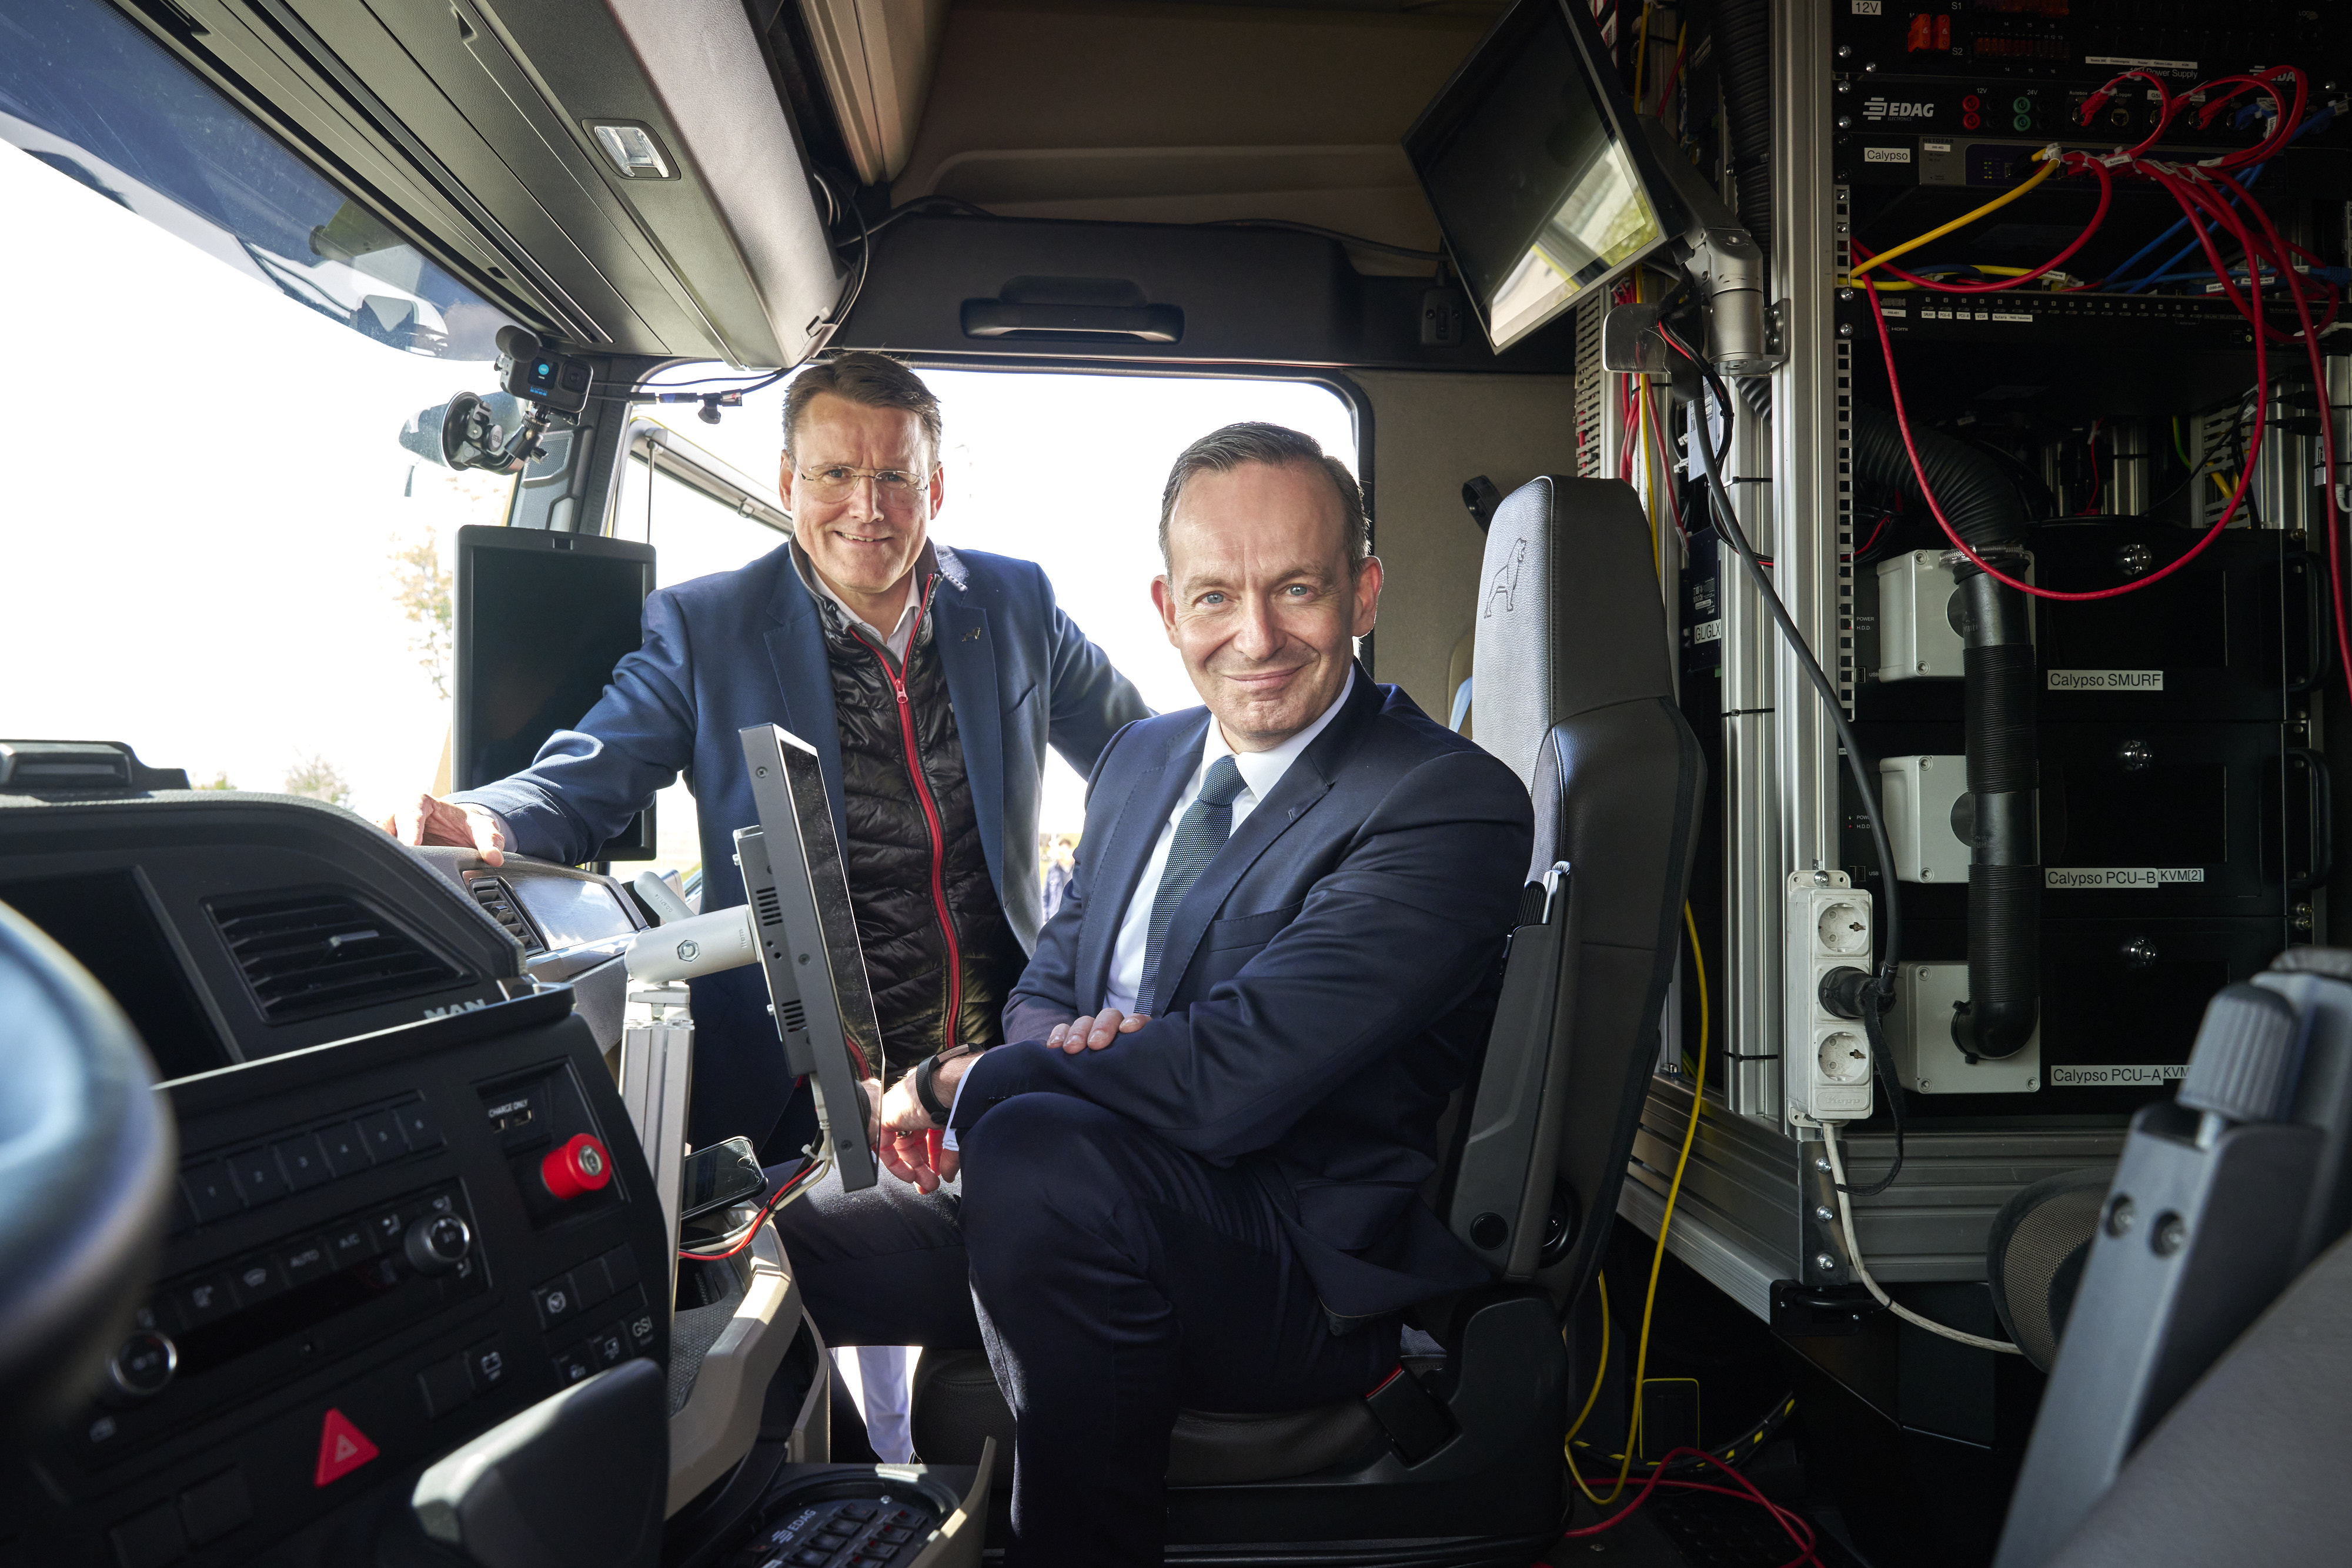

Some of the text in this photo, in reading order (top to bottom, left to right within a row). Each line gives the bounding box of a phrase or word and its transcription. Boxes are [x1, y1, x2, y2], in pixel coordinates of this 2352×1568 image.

[1856, 2, 1878, 13] 12V
[1952, 48, 1963, 56] S2
[2172, 69, 2198, 79] Supply
[1888, 102, 1935, 118] EDAG
[1867, 150, 1908, 162] Calypso
[1695, 622, 1720, 641] GL/GLX
[2050, 673, 2161, 688] Calypso SMURF
[2048, 871, 2102, 886] Calypso
[2160, 870, 2201, 881] KVM[2]
[423, 998, 487, 1019] MAN
[2053, 1068, 2108, 1084] Calypso
[488, 1098, 529, 1118] CHARGE ONLY
[632, 1315, 653, 1338] GSI
[787, 1509, 817, 1532] EDAG
